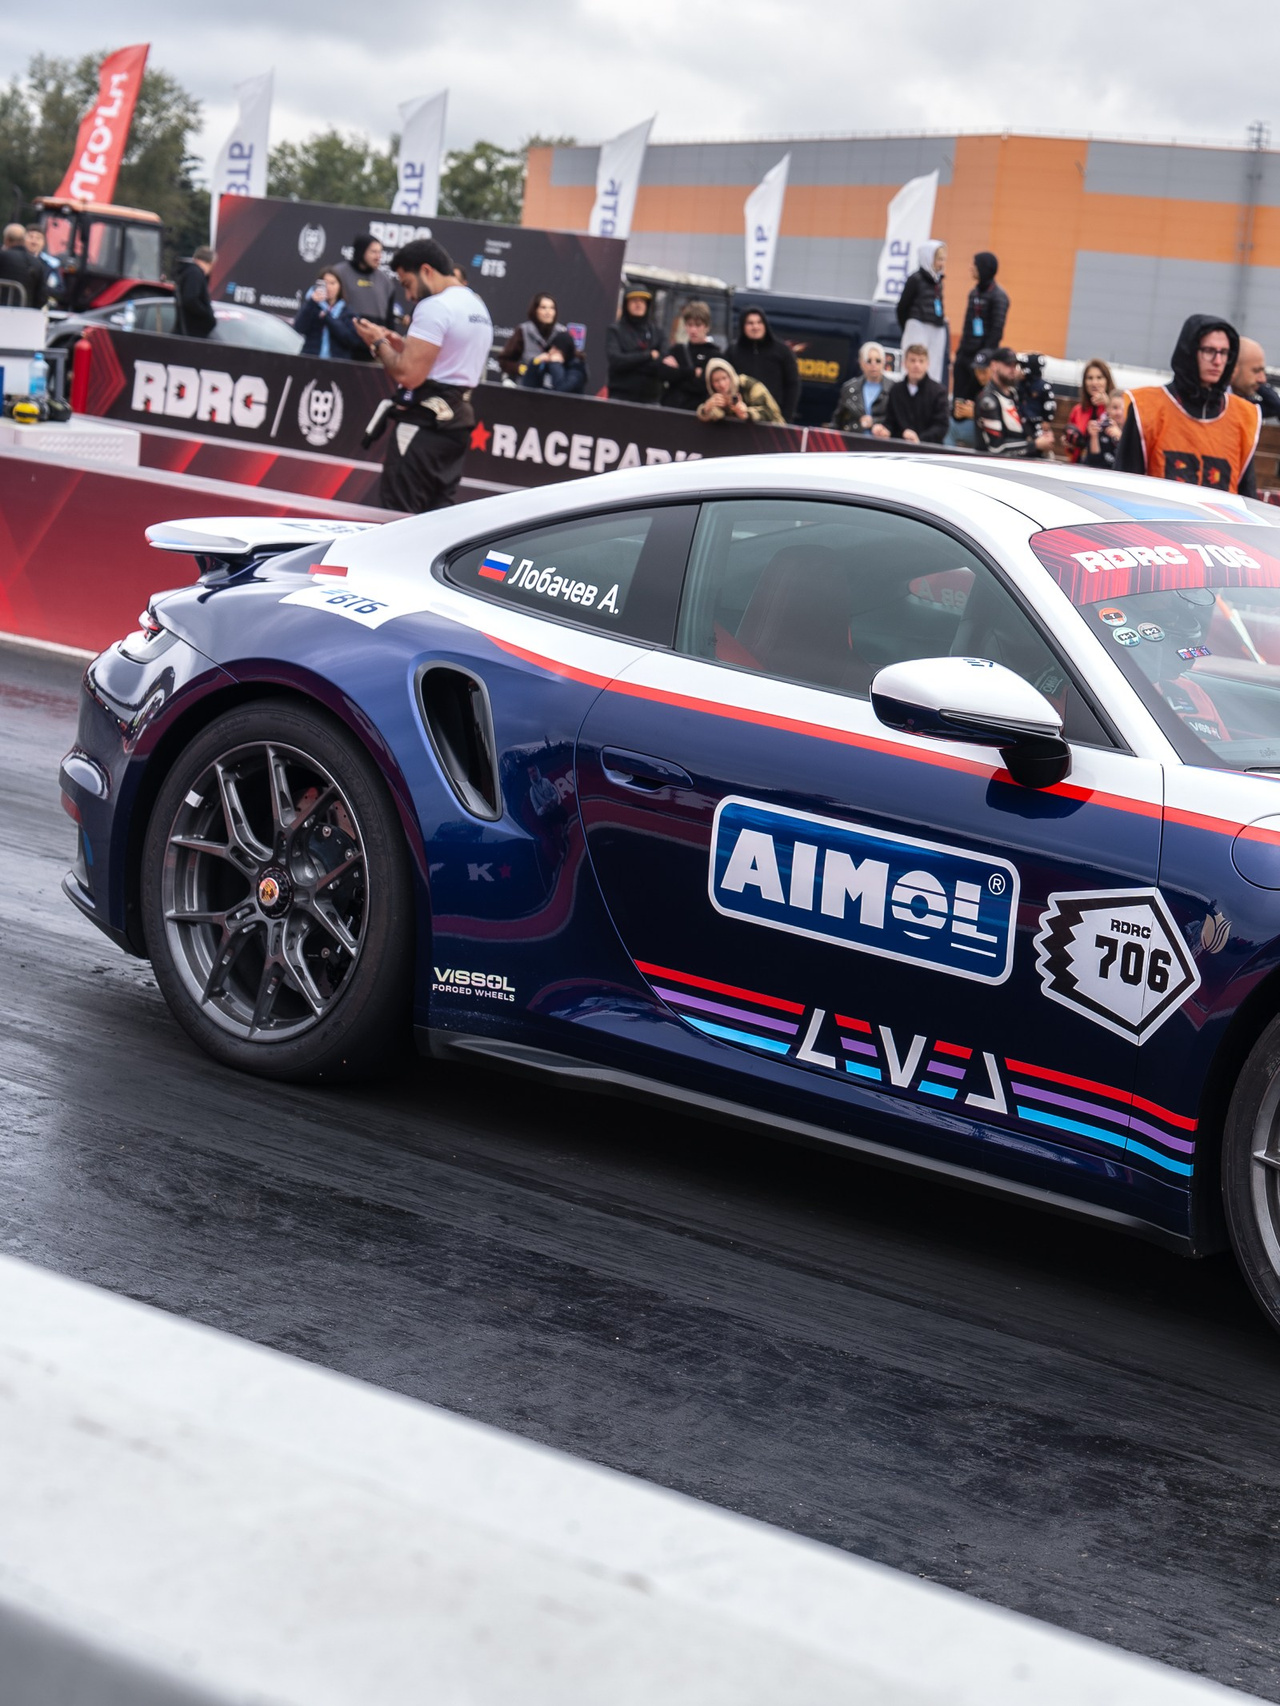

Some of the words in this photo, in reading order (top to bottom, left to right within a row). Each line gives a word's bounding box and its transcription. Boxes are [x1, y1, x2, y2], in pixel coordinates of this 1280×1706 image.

[131, 359, 269, 429] RDRC
[1070, 545, 1189, 574] RDRC
[1182, 543, 1262, 569] 706
[507, 558, 599, 607] Лобачев
[596, 583, 620, 615] А.
[325, 593, 390, 615] ВТБ
[720, 827, 998, 958] AIMOL
[1110, 918, 1152, 940] RDRC
[433, 966, 516, 992] VISSOL
[1094, 934, 1172, 994] 706
[432, 983, 472, 995] FORGED
[474, 988, 515, 1002] WHEELS
